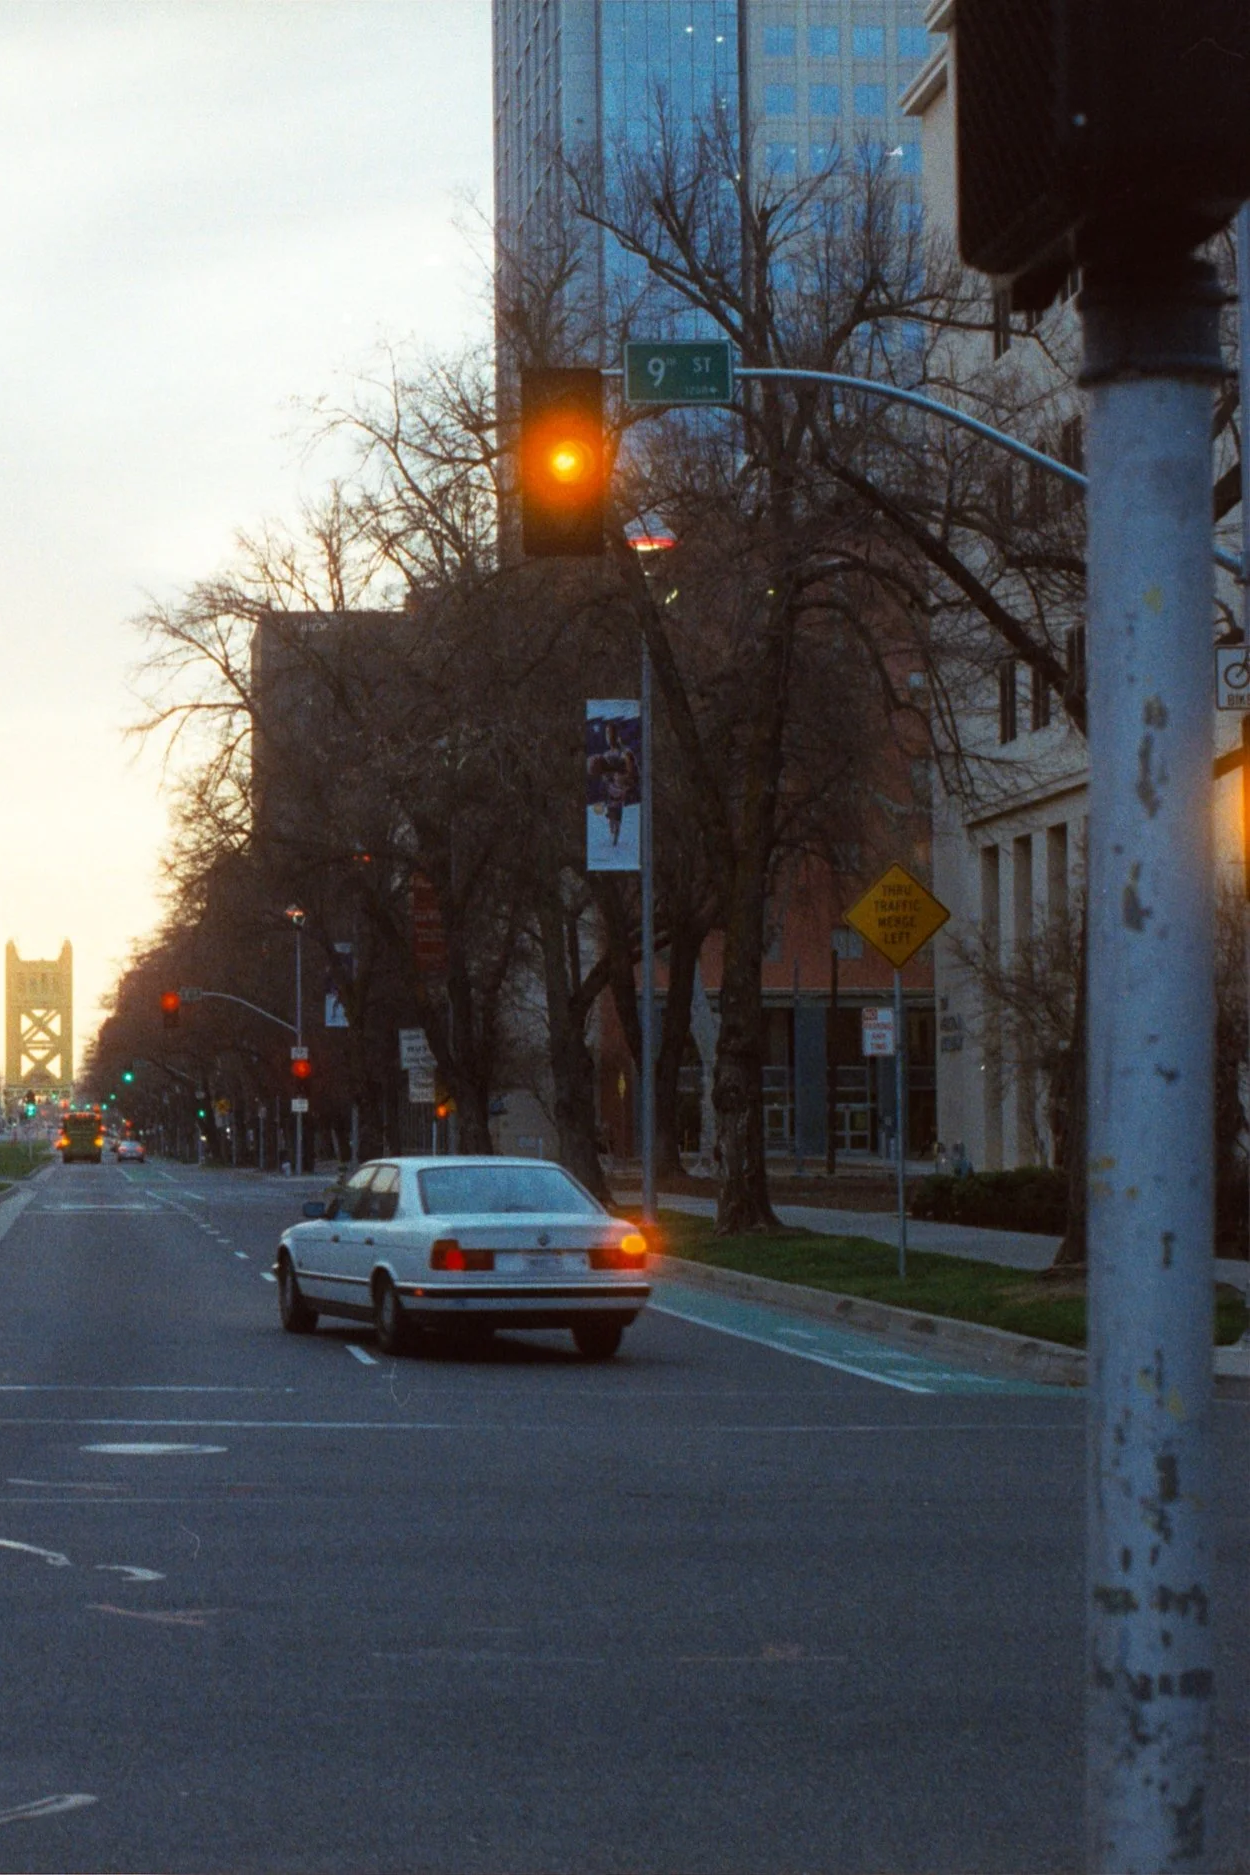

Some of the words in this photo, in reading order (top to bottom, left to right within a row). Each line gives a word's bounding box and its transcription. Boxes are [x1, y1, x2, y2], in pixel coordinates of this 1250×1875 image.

[693, 356, 711, 373] ST
[882, 884, 912, 897] THRU
[874, 899, 921, 913] TRAFFIC
[877, 914, 917, 929] MERGE
[884, 931, 911, 945] LEFT
